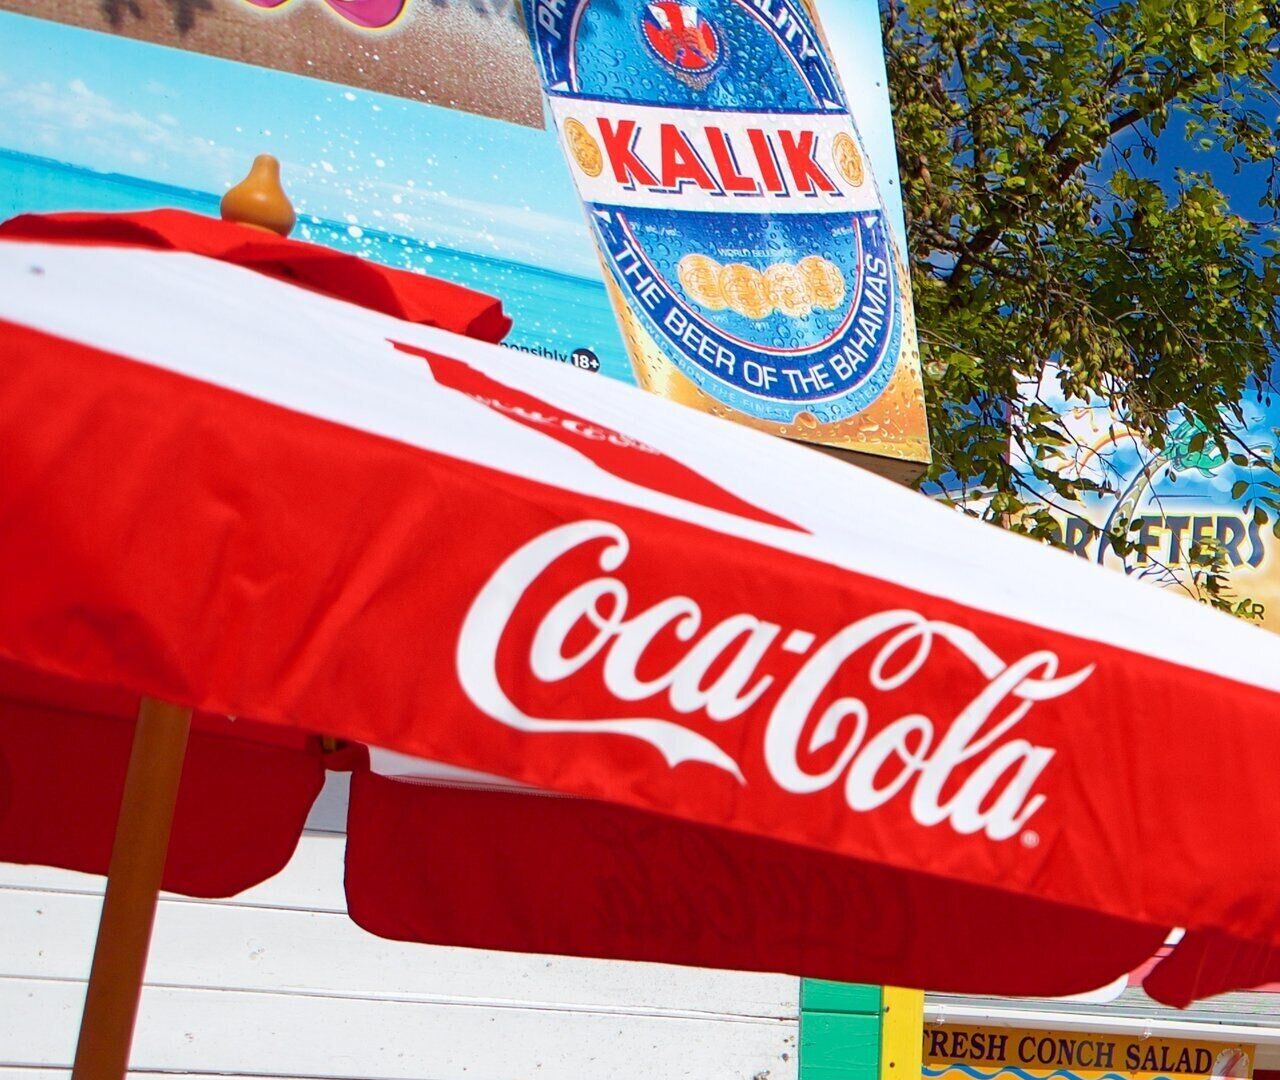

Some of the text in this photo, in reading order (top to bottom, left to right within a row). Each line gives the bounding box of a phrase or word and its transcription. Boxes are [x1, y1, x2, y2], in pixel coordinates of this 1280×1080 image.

[597, 117, 845, 199] KALIK
[614, 240, 666, 311] THE
[663, 306, 737, 376] BEER
[743, 360, 778, 391] OF
[782, 364, 834, 394] THE
[829, 253, 889, 380] BAHAMAS
[572, 353, 600, 369] 18+
[456, 519, 1095, 842] Coca-Cola
[1018, 1036, 1115, 1069] CONCH
[1126, 1043, 1212, 1074] SALAD
